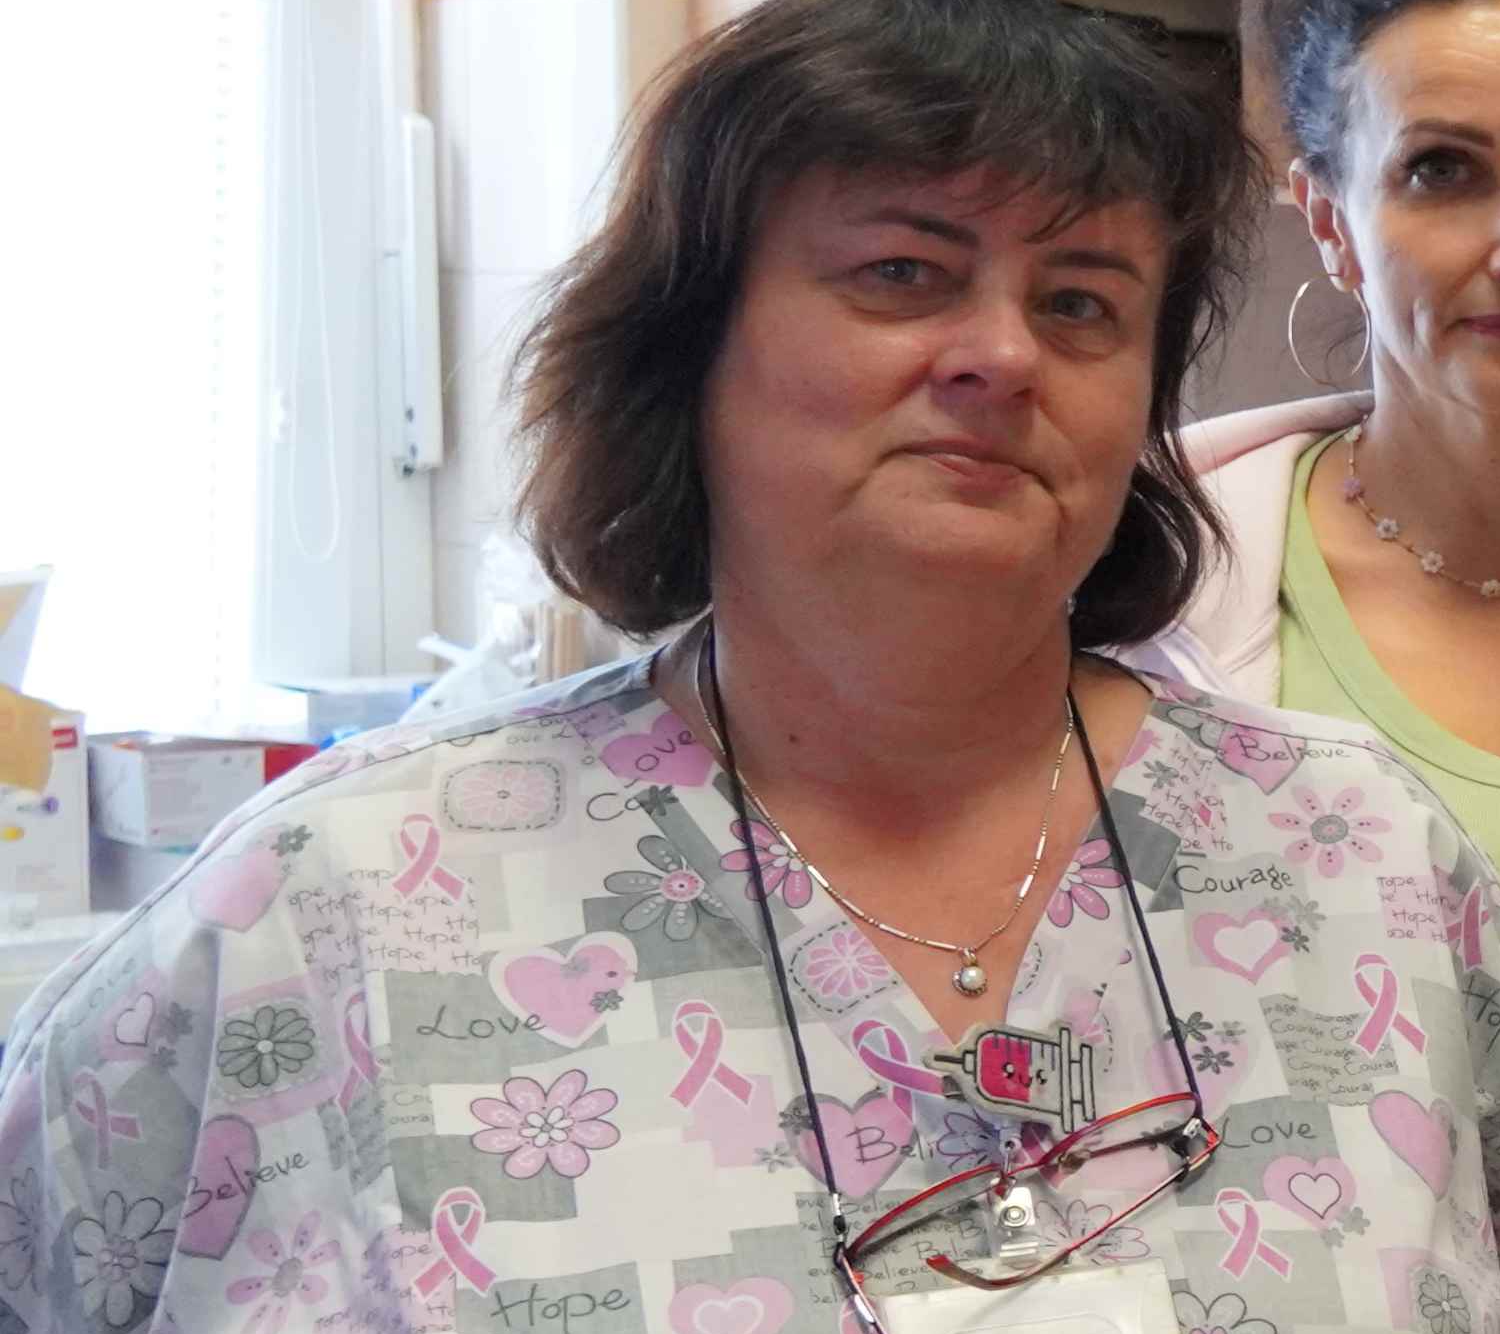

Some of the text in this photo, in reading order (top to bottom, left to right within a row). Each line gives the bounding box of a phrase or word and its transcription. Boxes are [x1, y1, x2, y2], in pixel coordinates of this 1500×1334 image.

[1230, 732, 1353, 763] Believe
[1173, 865, 1294, 893] Courage
[416, 1003, 546, 1042] Love
[1219, 1116, 1316, 1151] Love
